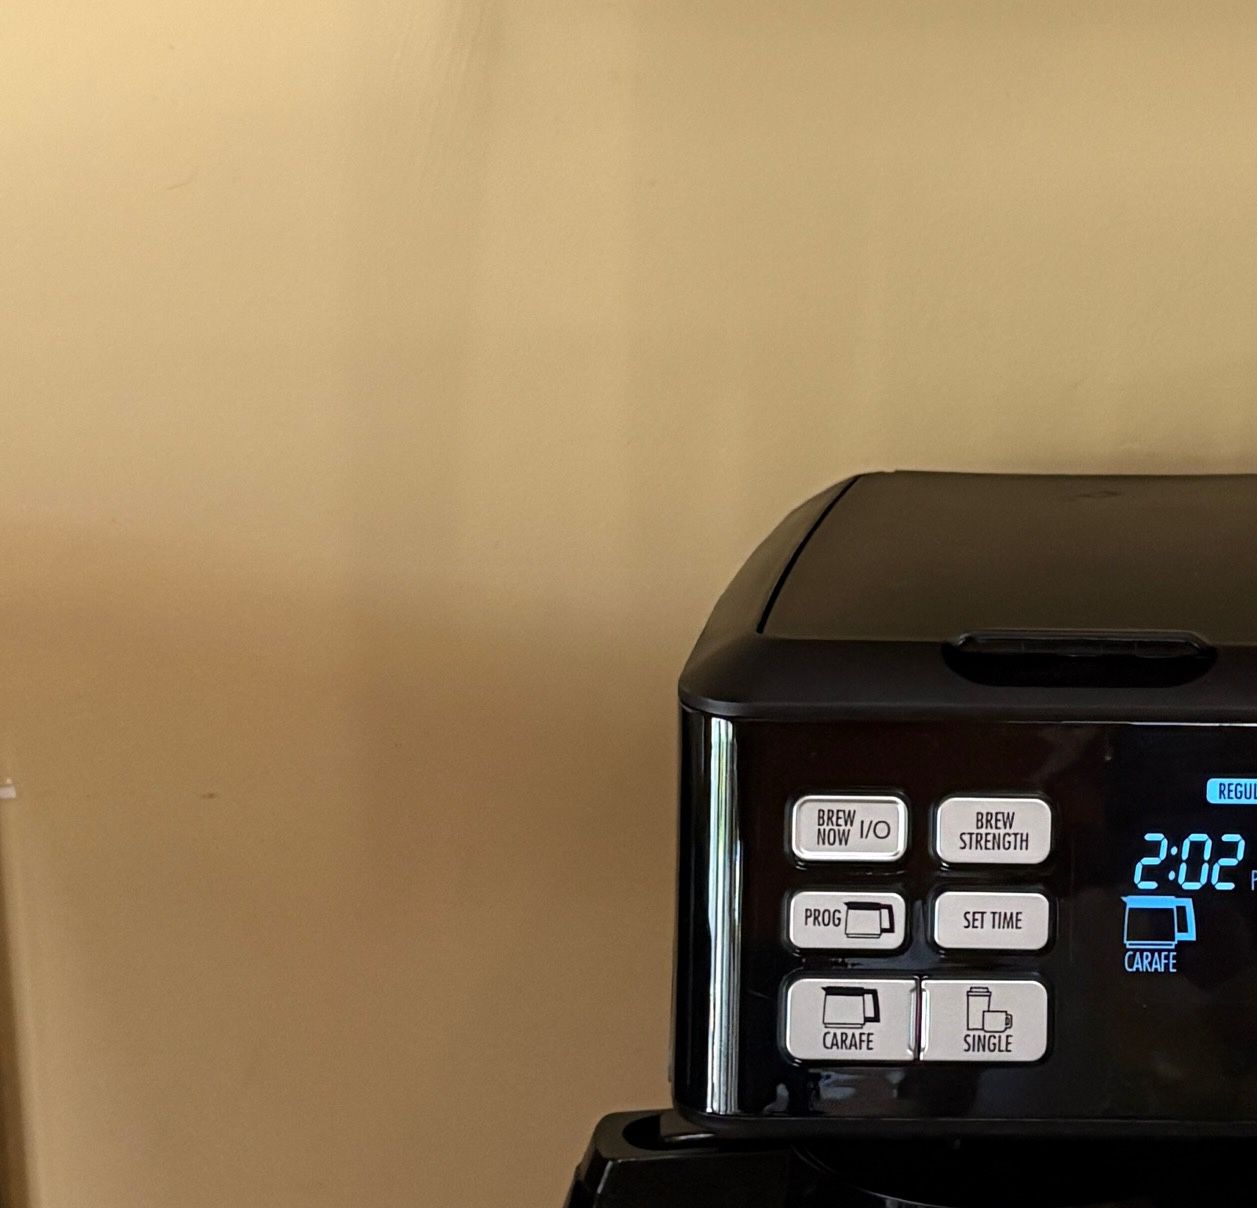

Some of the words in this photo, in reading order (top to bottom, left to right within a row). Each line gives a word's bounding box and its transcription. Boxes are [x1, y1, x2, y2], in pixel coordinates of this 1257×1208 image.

[817, 809, 855, 827] BREW
[976, 812, 1015, 830] BREW
[817, 828, 850, 846] NOW
[959, 832, 1029, 851] STRENGTH
[1134, 833, 1245, 891] 2:02
[804, 909, 841, 928] PROG
[963, 911, 987, 930] SET
[990, 911, 1023, 930] TIME
[1125, 951, 1177, 972] CARAFE
[822, 1031, 874, 1051] CARAFE
[963, 1034, 1013, 1053] SINGLE
